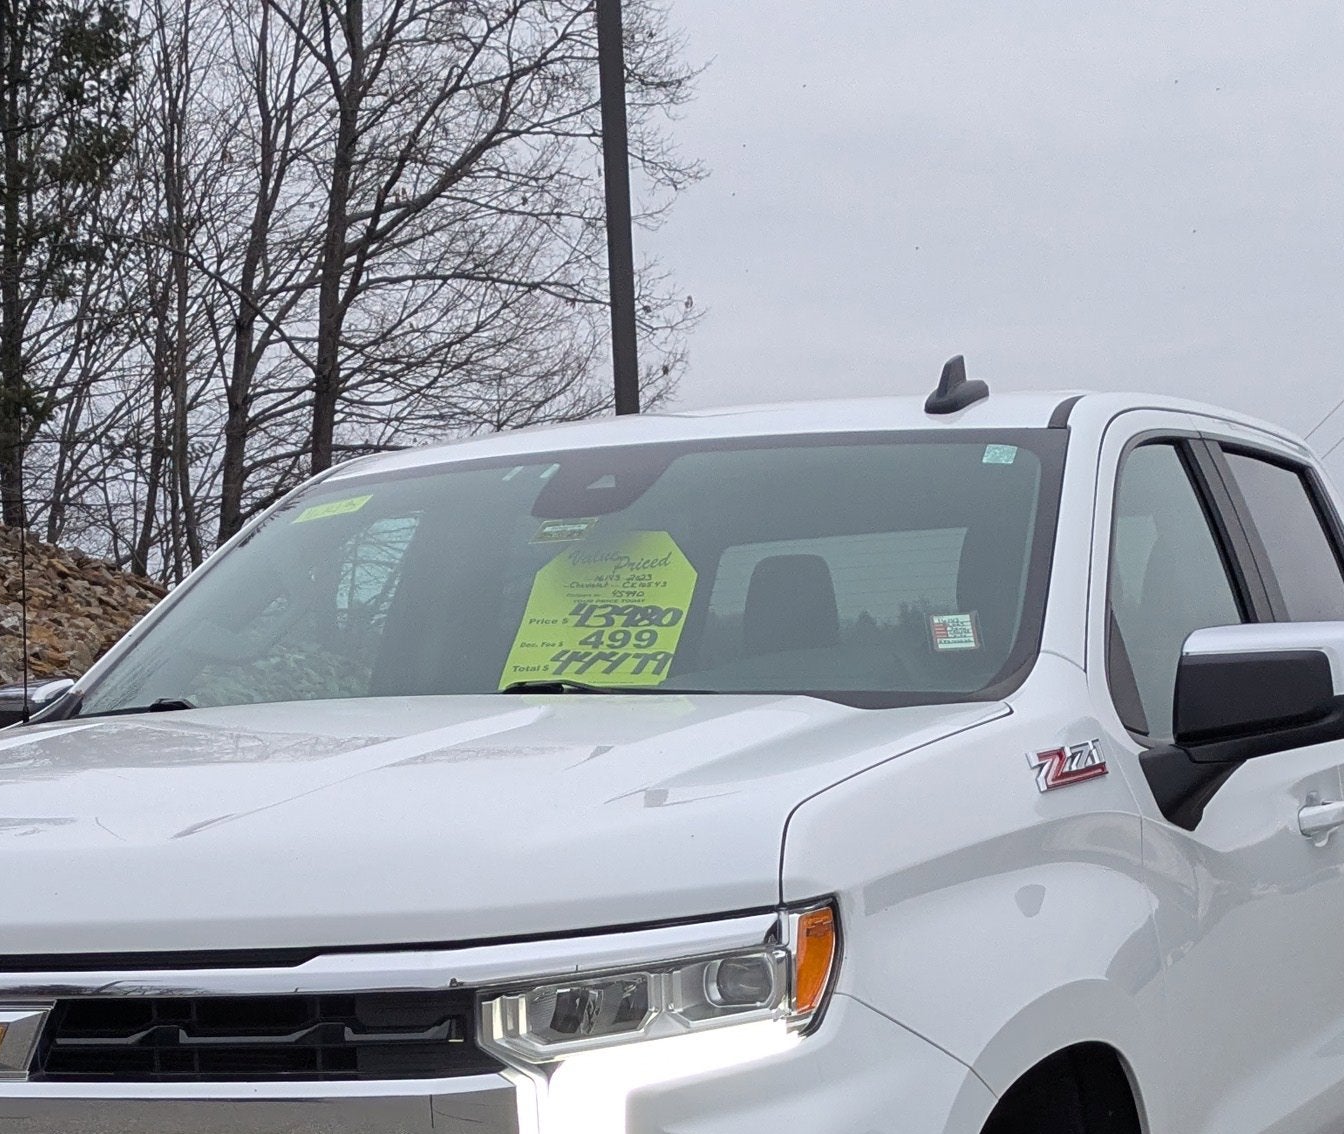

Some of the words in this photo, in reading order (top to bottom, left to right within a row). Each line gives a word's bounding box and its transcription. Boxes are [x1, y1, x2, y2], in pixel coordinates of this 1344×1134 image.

[568, 550, 621, 566] Value
[612, 551, 673, 576] Priced
[562, 617, 569, 625] $
[578, 628, 658, 649] 499
[511, 665, 541, 673] Total
[542, 664, 550, 672] $
[1024, 738, 1110, 793] Z71
